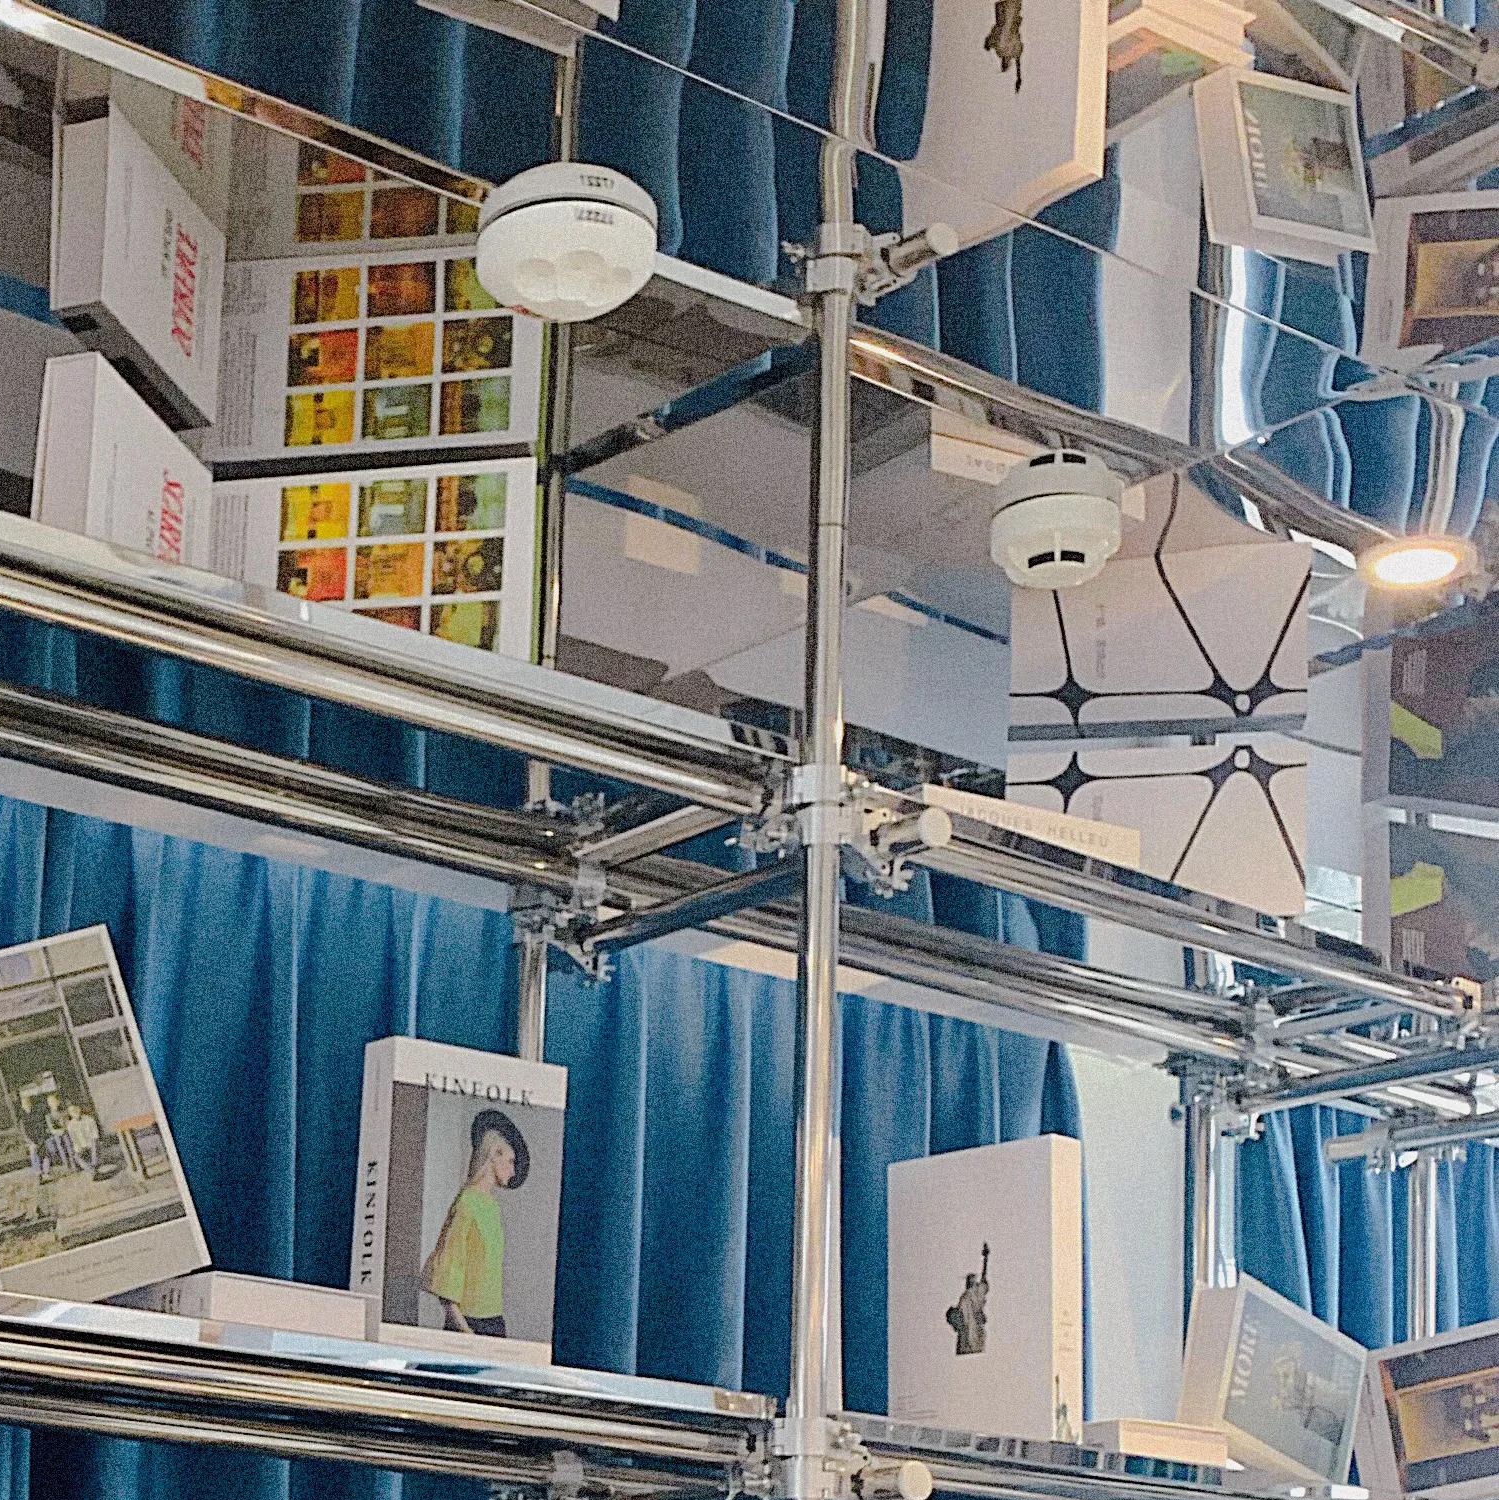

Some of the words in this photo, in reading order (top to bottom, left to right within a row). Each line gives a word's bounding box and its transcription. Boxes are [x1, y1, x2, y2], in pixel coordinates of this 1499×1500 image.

[423, 1071, 536, 1107] KINFOLK
[359, 1159, 379, 1285] KINFOLK
[1230, 1316, 1260, 1406] MORE
